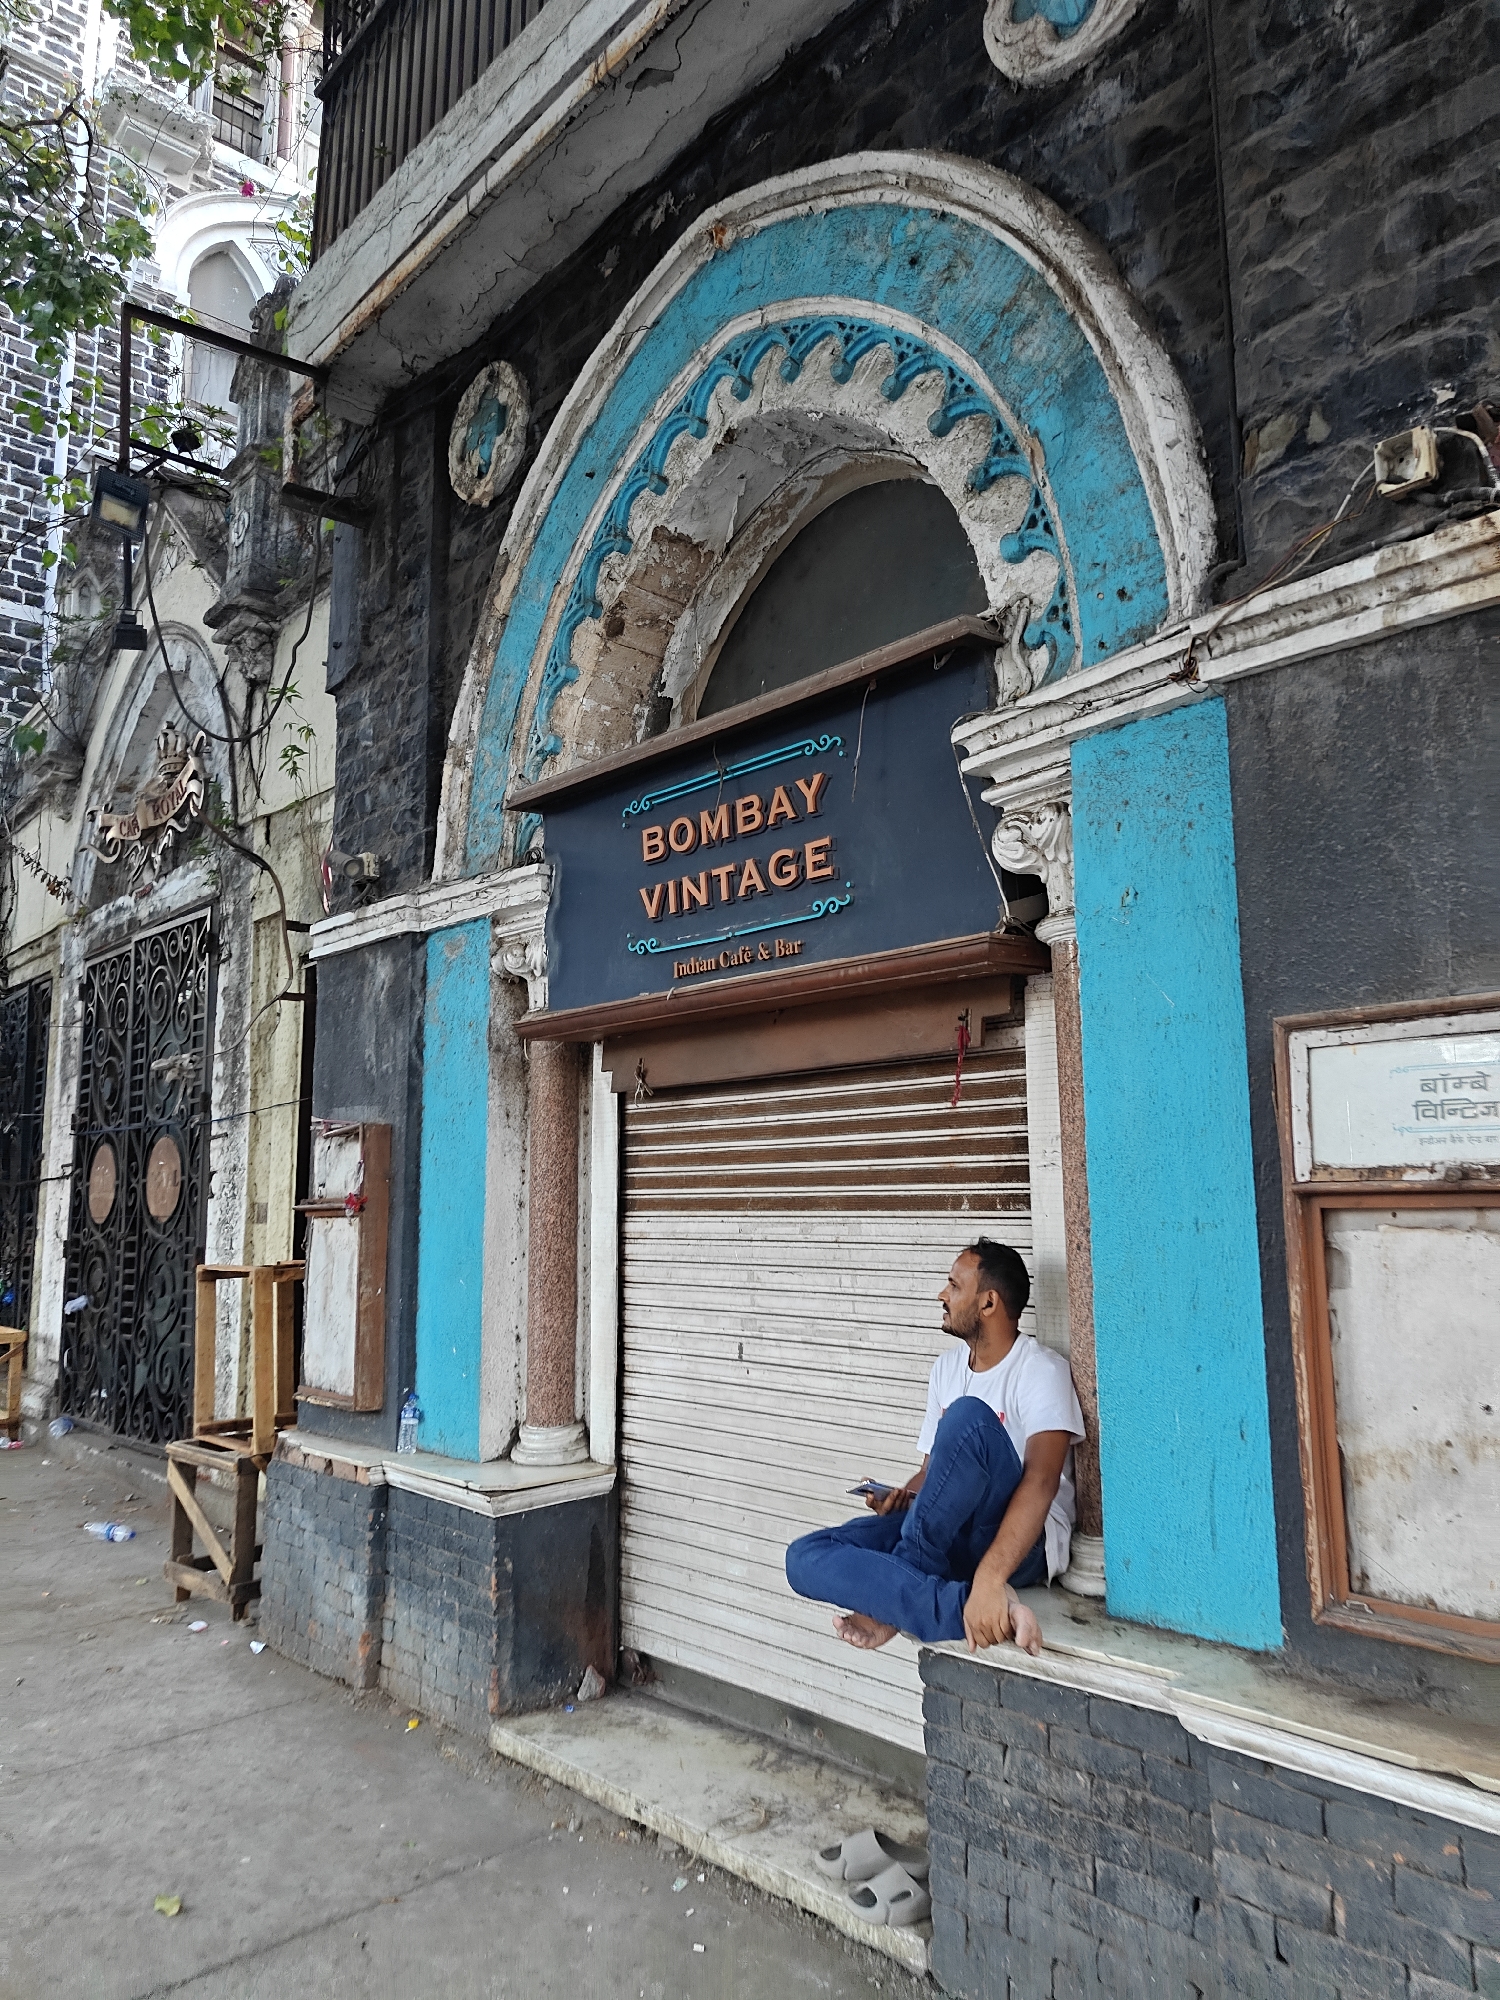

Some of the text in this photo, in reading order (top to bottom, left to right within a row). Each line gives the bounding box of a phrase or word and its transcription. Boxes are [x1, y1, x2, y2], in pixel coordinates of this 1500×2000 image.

[641, 772, 828, 864] BOMBAY
[639, 835, 837, 920] VINTAGE
[673, 956, 717, 979] Indian
[757, 941, 771, 961] &
[775, 938, 804, 958] Bar
